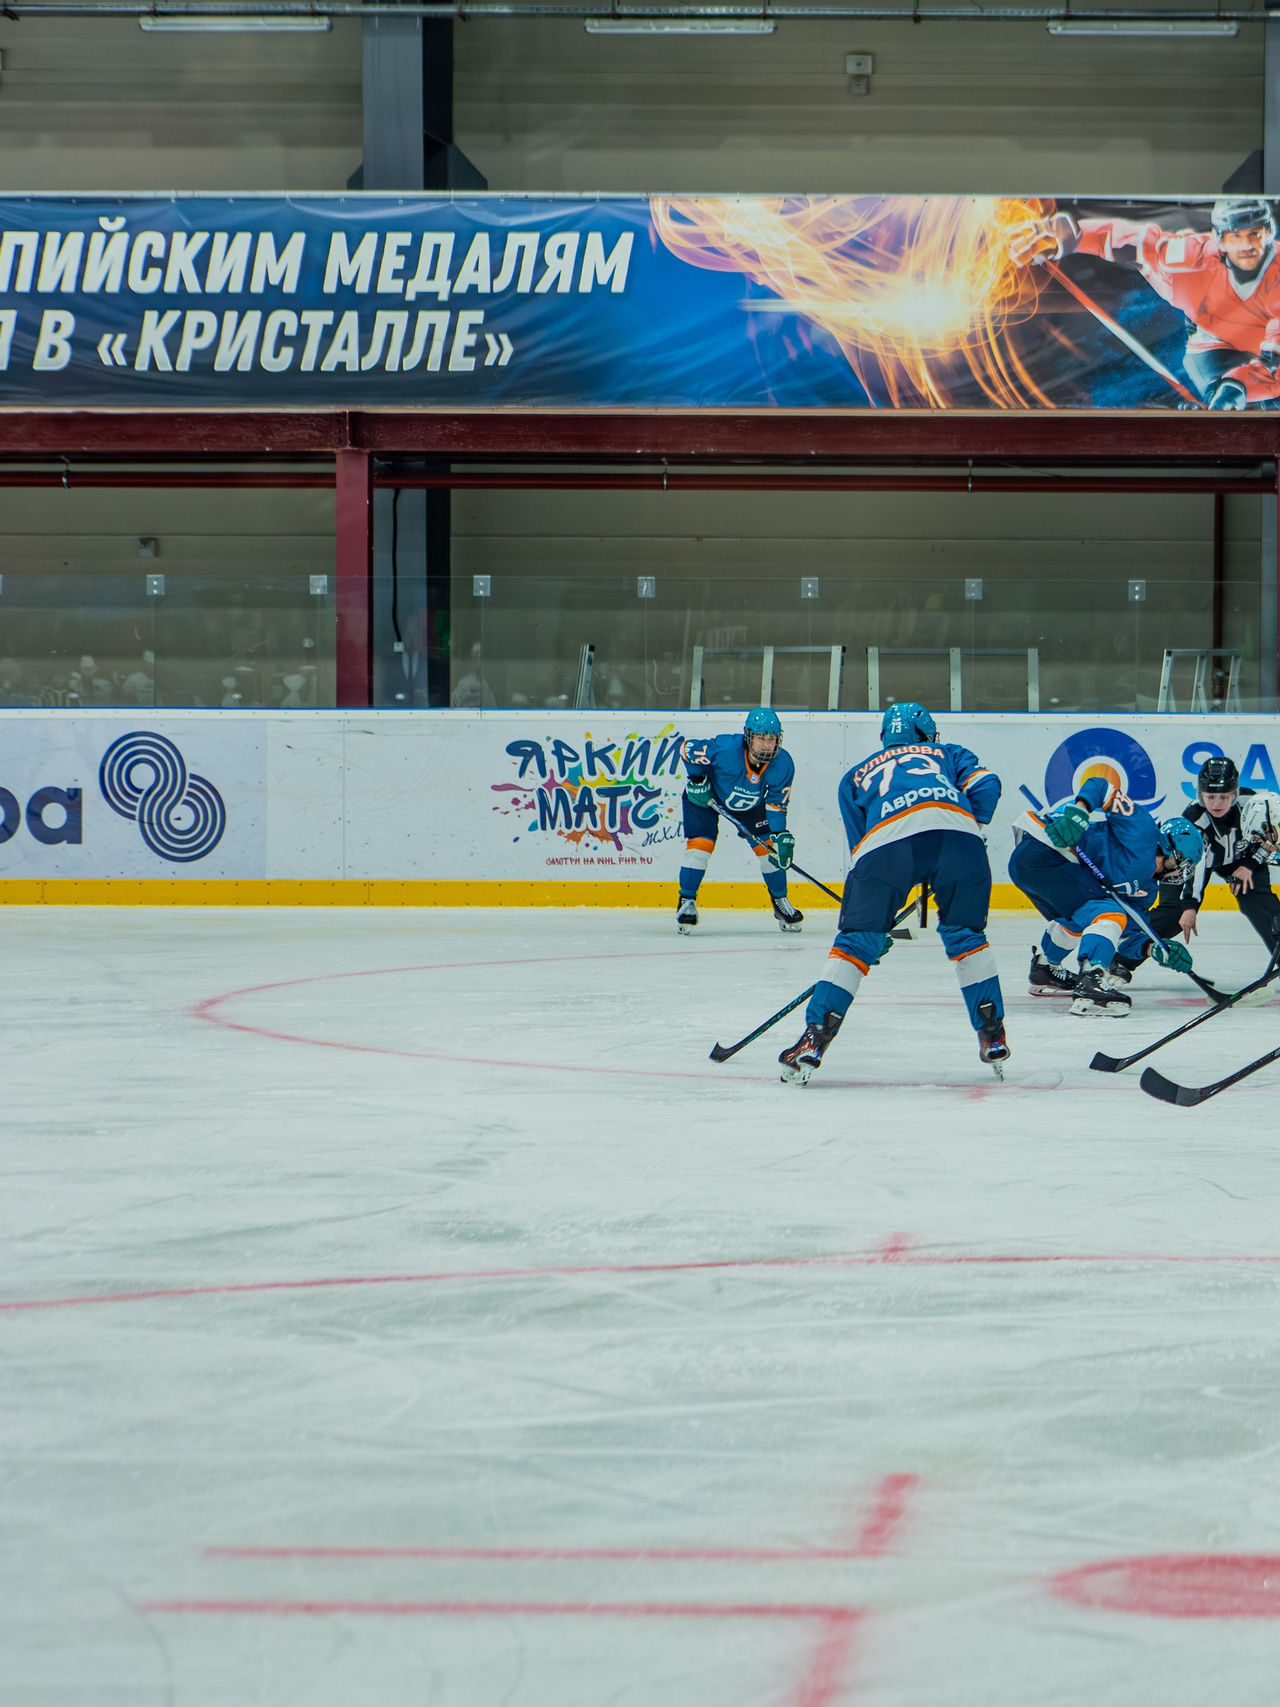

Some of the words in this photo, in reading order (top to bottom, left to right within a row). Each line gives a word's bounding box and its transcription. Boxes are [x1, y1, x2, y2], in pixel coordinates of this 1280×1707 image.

[0, 216, 306, 295] ПИЙСКИМ
[323, 230, 635, 301] МЕДАЛЯМ
[32, 308, 76, 372] В
[97, 308, 515, 373] «КРИСТАЛЛЕ»
[890, 721, 903, 734] 73
[505, 731, 685, 779] ЯРКИЙ
[852, 745, 945, 788] КУЛИШОВА
[860, 753, 941, 797] 73
[880, 786, 959, 819] Аврора
[755, 819, 769, 828] CC
[545, 856, 581, 866] СМОТРИ
[583, 856, 596, 866] НА
[596, 856, 653, 866] WHL.FHR.RU
[1078, 851, 1105, 880] BAUER
